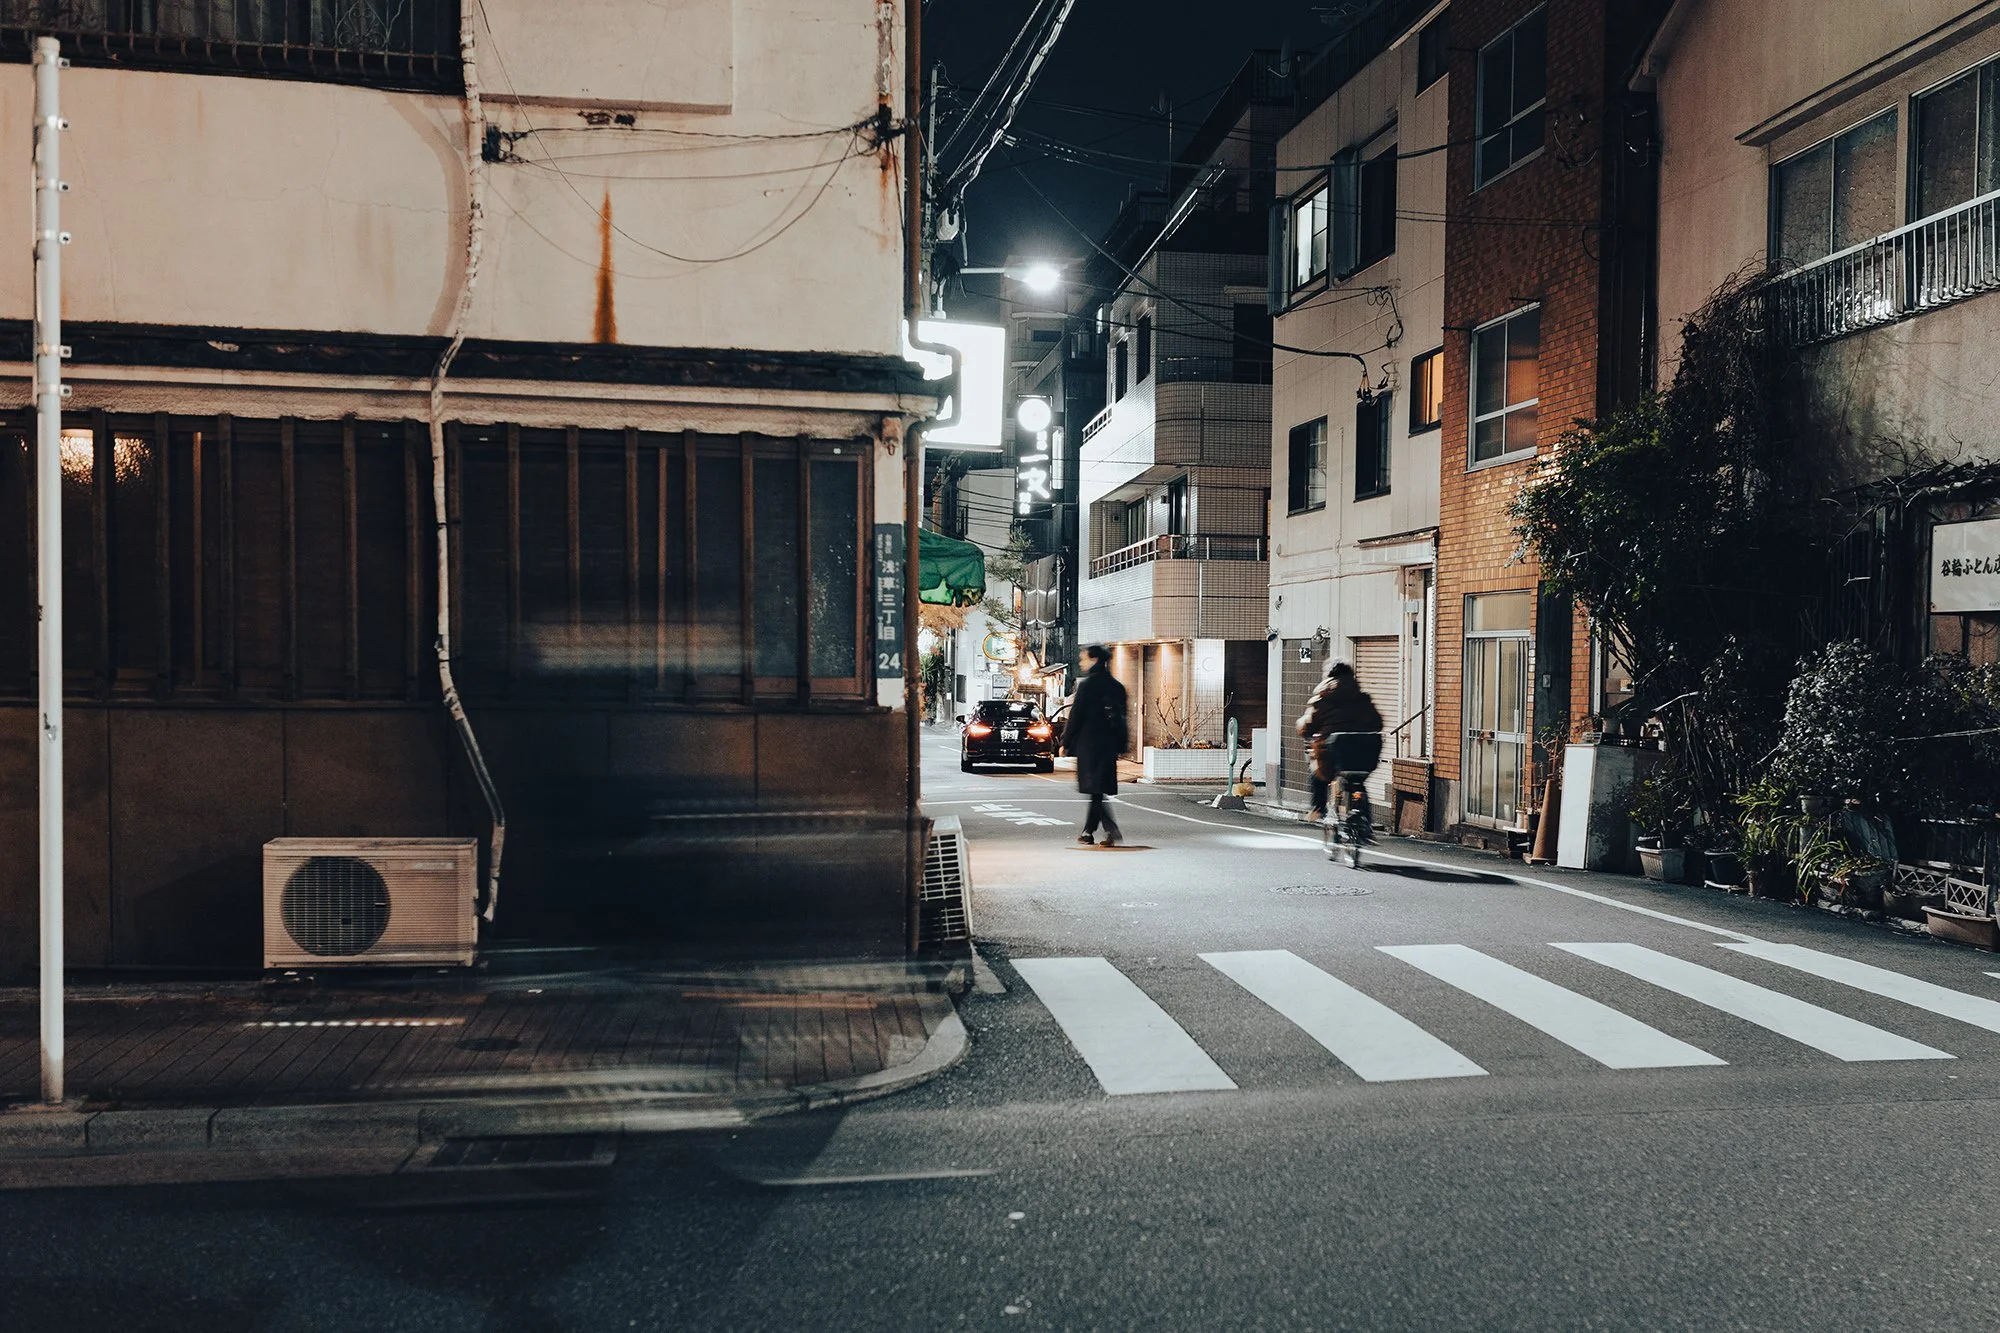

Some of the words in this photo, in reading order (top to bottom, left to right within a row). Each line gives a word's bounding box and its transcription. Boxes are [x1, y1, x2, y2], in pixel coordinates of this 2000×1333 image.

[882, 560, 896, 640] 浅草三丁目
[879, 652, 900, 669] 24
